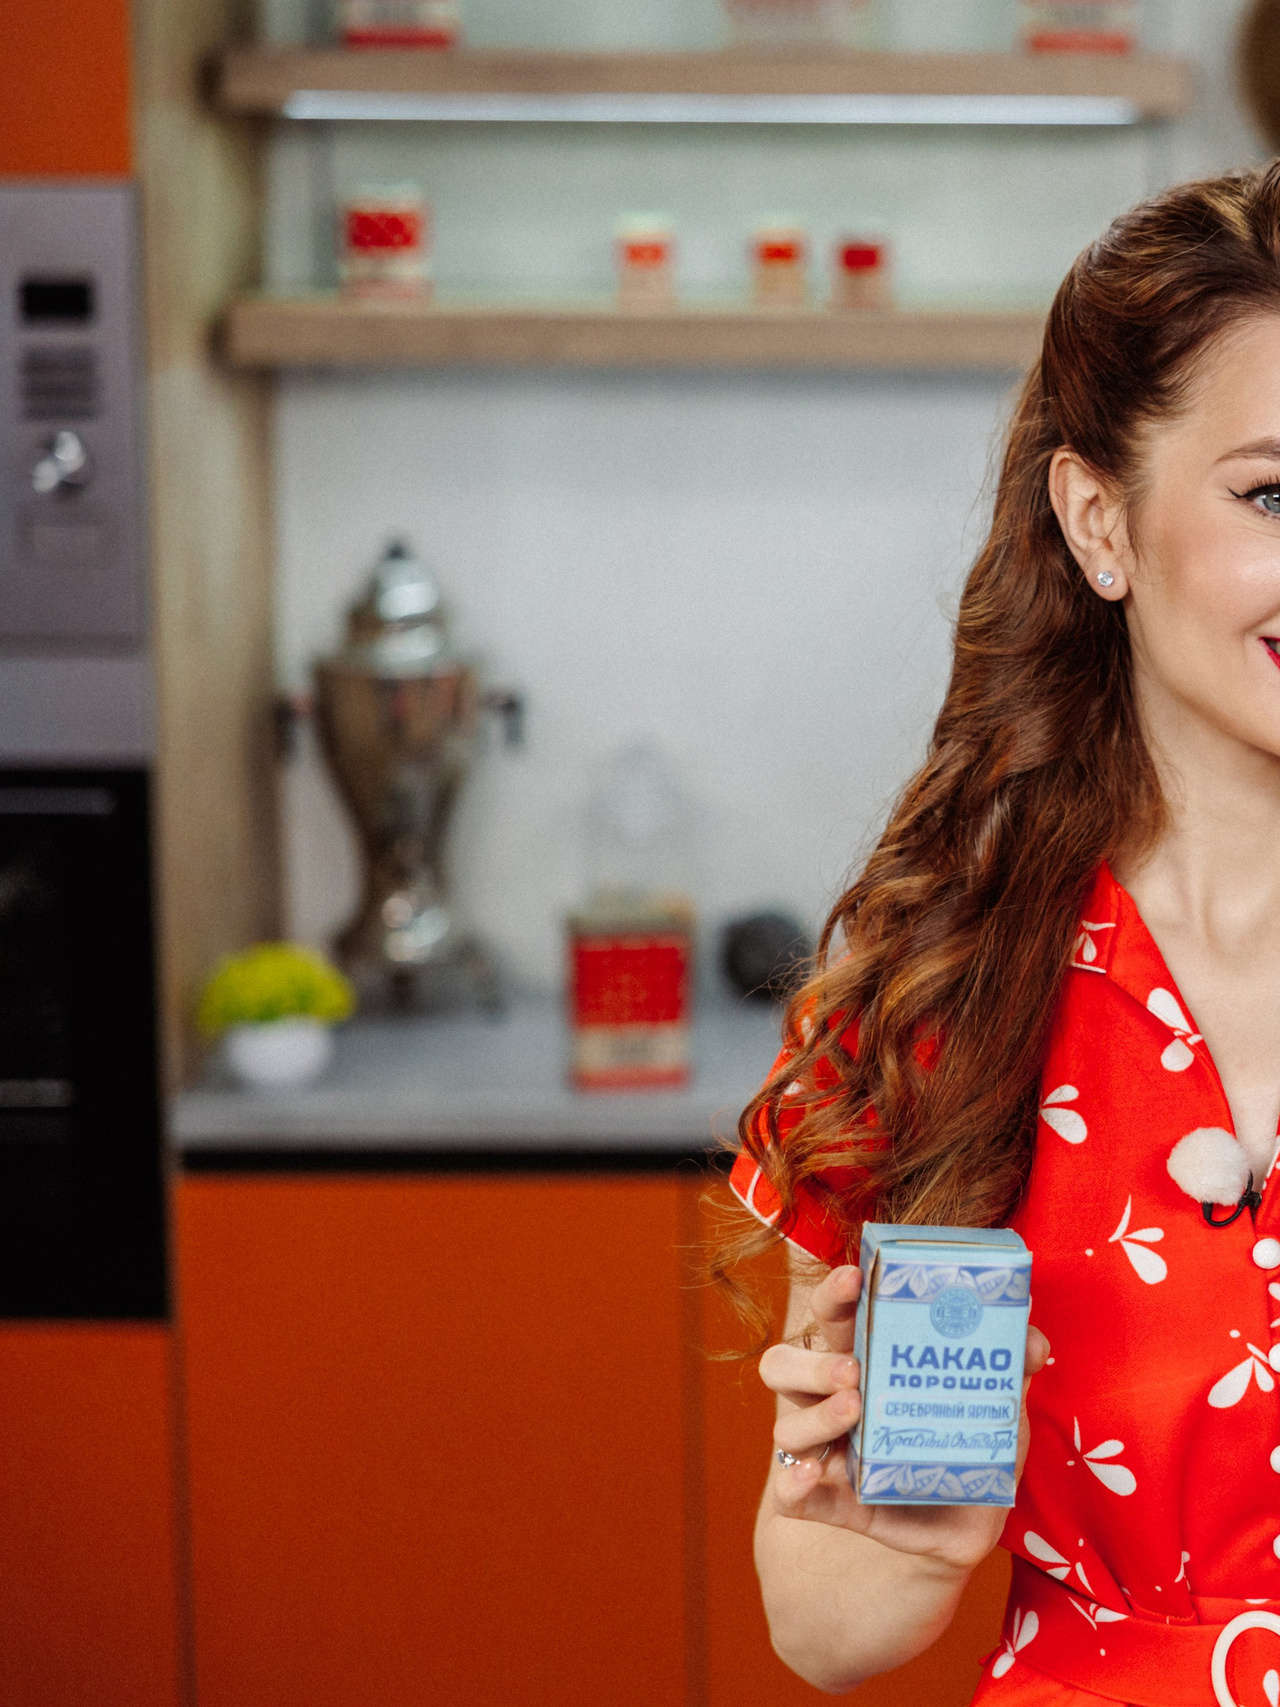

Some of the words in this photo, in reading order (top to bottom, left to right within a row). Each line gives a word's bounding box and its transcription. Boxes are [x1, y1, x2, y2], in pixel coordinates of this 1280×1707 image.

[890, 1343, 1013, 1372] КАКАО
[888, 1373, 1015, 1391] ПОРОШОК
[884, 1400, 965, 1419] СЕРЕБРЯНЫЙ
[967, 1404, 1011, 1419] ЯРЛЫК
